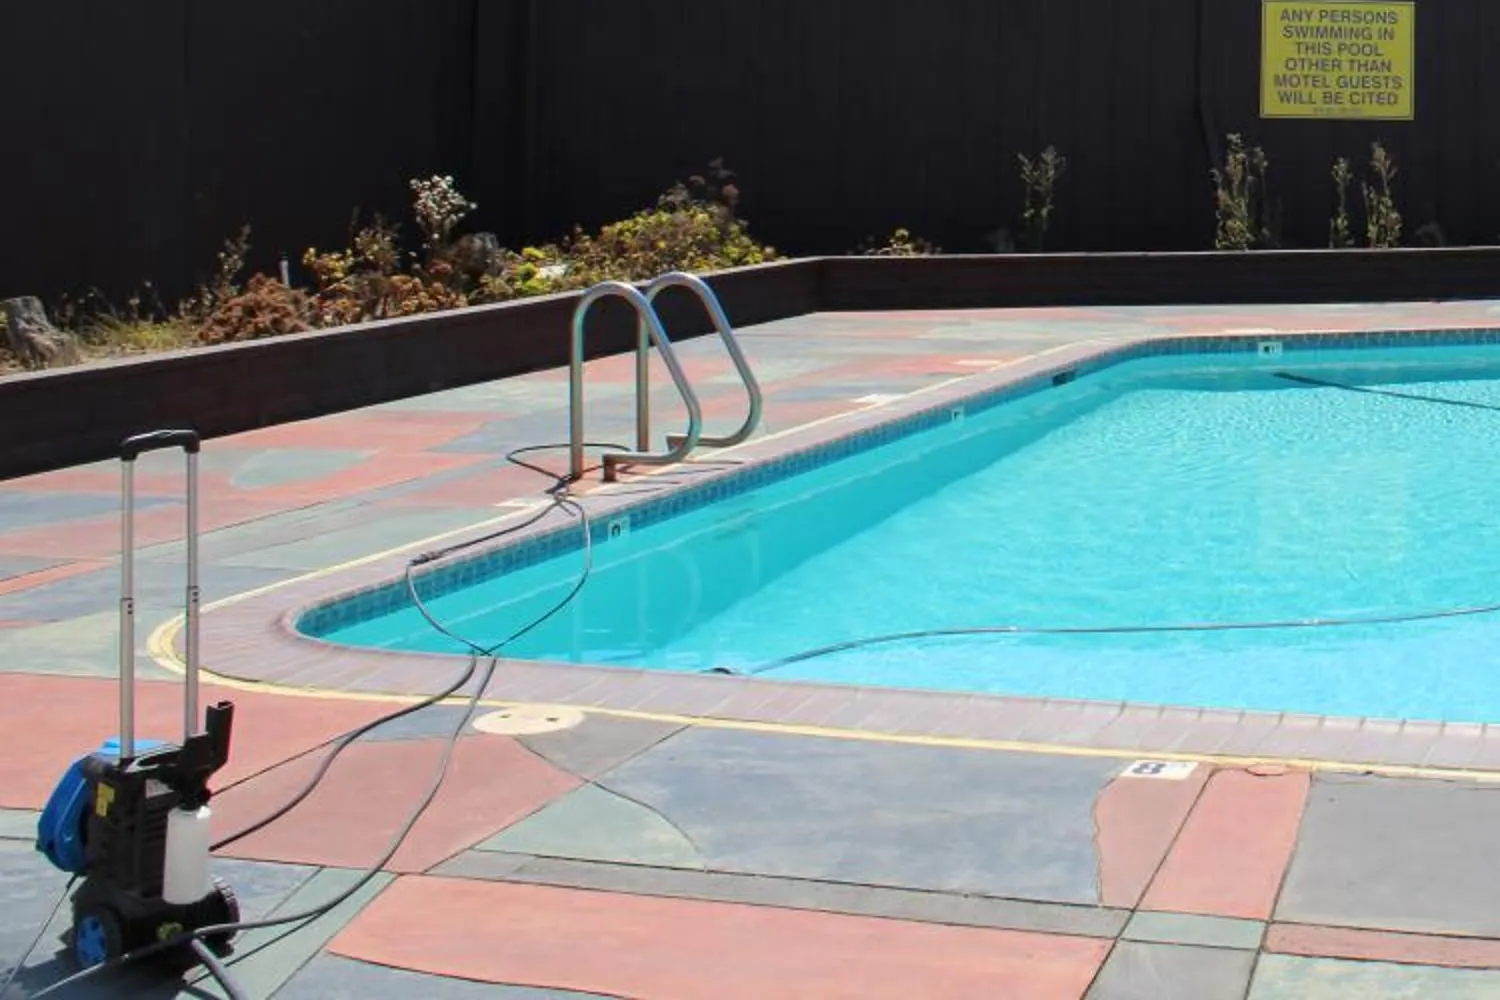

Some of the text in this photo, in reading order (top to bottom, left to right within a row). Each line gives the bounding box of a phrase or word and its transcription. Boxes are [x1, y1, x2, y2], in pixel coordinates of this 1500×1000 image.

[1280, 8, 1398, 24] ANY PERSONS
[1282, 25, 1394, 40] SWIMMING IN
[1295, 42, 1384, 56] THIS POOL
[1285, 58, 1391, 72] OTHER THAN
[1274, 74, 1403, 89] MOTEL GUESTS
[1278, 91, 1398, 105] WILL BE CITED
[1132, 762, 1166, 775] 8
